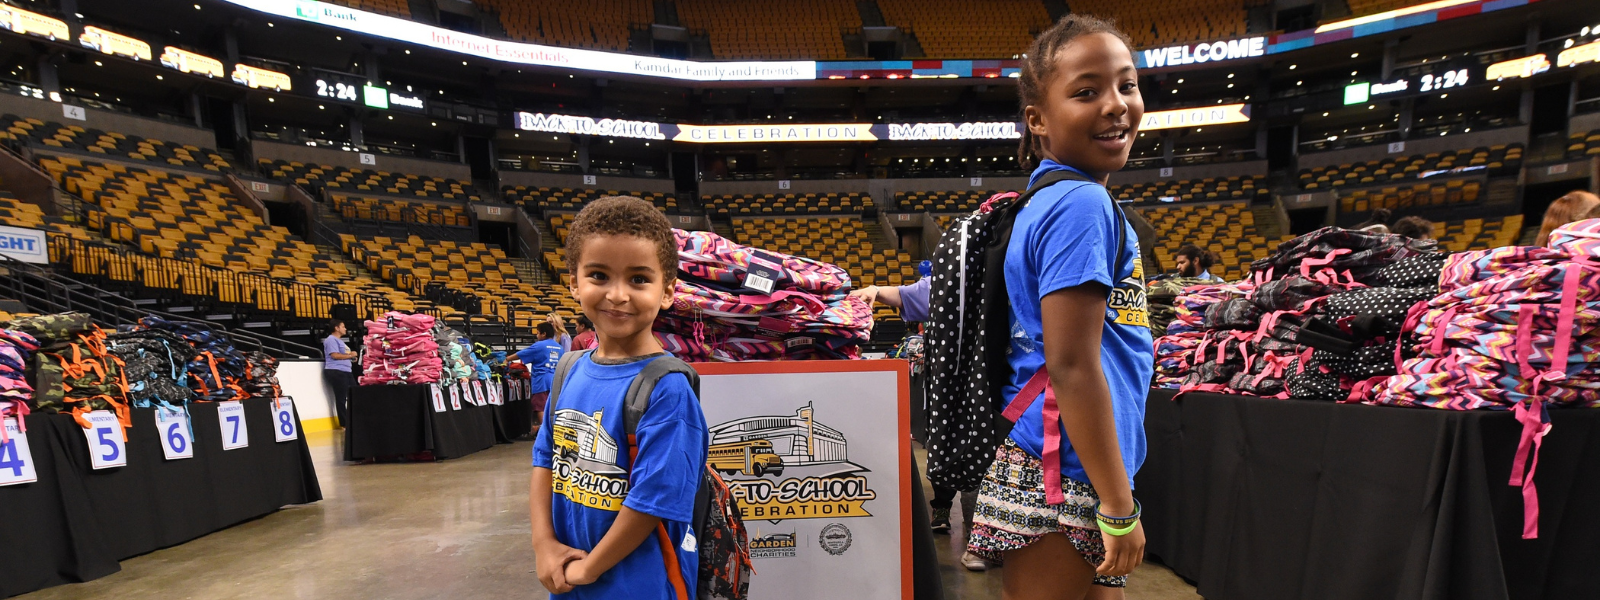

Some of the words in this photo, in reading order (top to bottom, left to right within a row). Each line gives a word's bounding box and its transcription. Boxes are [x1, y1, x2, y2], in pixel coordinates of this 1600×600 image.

[324, 8, 357, 21] Bank
[432, 31, 490, 54] Internet
[495, 44, 569, 63] Essentials
[1144, 37, 1264, 68] WELCOME
[634, 59, 682, 75] Kamdar
[687, 65, 725, 80] Family
[729, 65, 751, 76] and
[755, 65, 799, 76] Friends
[1420, 69, 1468, 92] 2:24
[316, 79, 356, 100] 2:24
[390, 93, 423, 109] Bank
[70, 108, 78, 117] 4
[691, 127, 857, 140] CELEBRATION
[364, 155, 370, 163] 5
[586, 176, 591, 184] 5
[435, 393, 441, 409] 1
[452, 392, 459, 407] 2
[477, 389, 484, 403] 4
[490, 388, 495, 403] 5
[226, 416, 239, 444] 7
[279, 411, 293, 436] 8
[97, 427, 119, 461] 5
[167, 423, 186, 453] 6
[0, 438, 25, 476] 4
[750, 540, 794, 548] GARDEN
